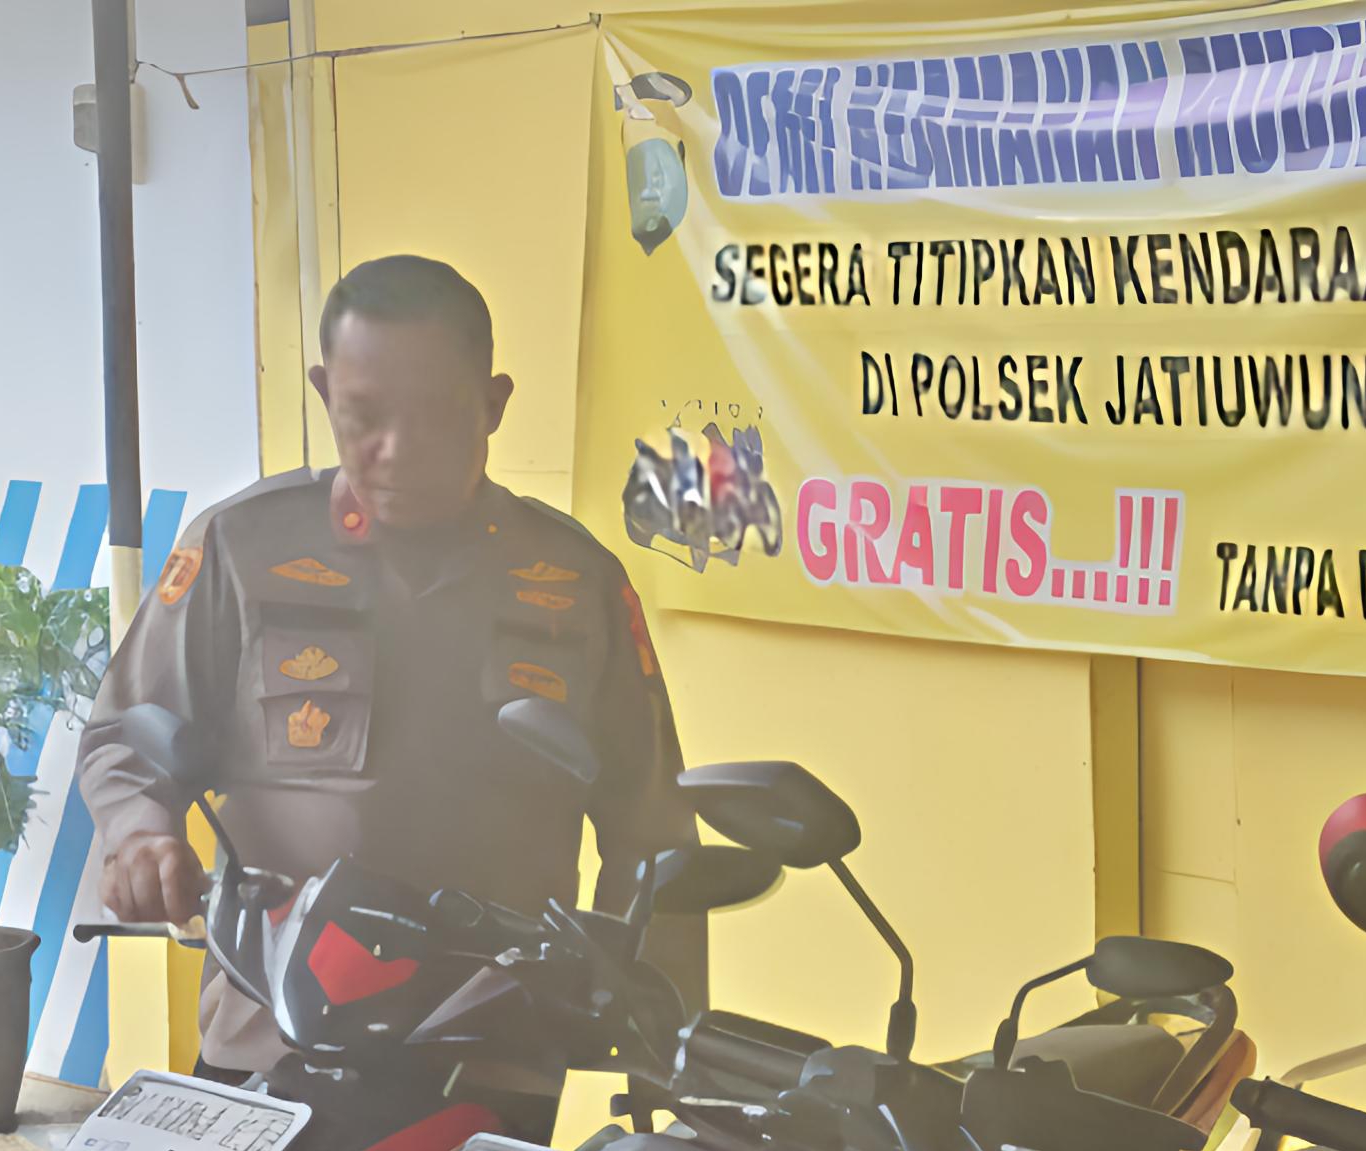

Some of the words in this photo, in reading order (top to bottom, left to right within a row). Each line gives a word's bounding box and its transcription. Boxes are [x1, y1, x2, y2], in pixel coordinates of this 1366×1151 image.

[711, 242, 872, 306] SEGERA
[887, 236, 1097, 306] TITIPKAN
[861, 351, 899, 417] DI
[911, 354, 1089, 425] POLSEK
[1216, 542, 1345, 620] TANPA
